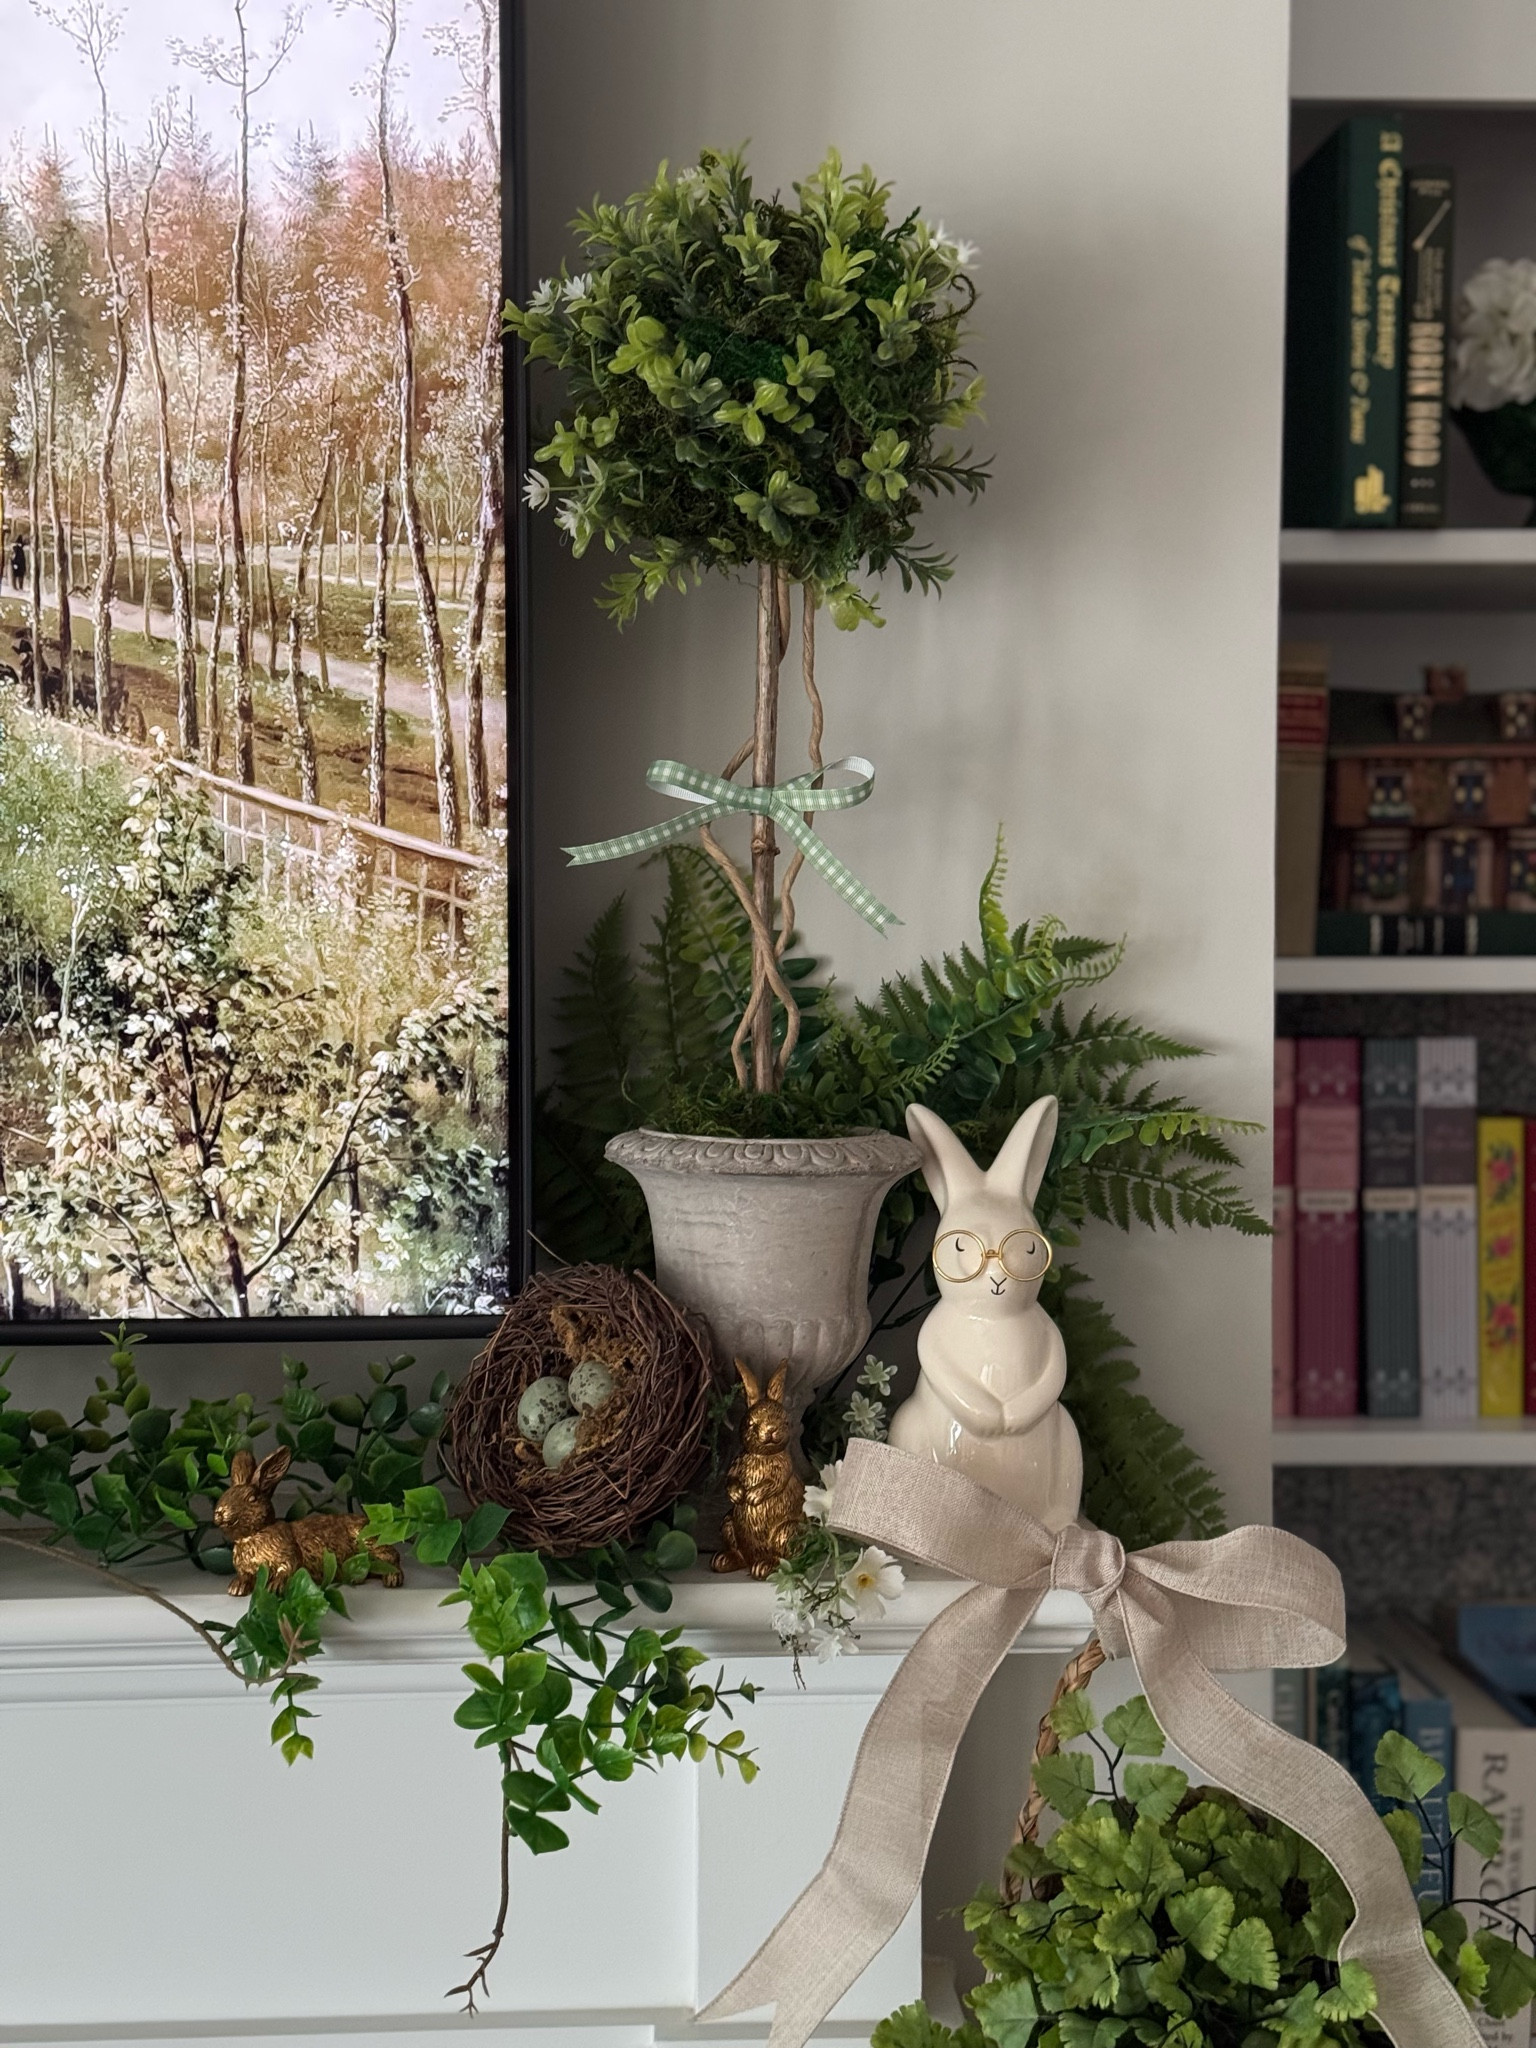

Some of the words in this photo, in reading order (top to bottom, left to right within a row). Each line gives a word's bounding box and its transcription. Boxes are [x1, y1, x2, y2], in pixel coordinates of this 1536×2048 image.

[1376, 158, 1402, 267] Christmas
[1408, 322, 1445, 396] ROBIN
[1405, 402, 1443, 466] HOOD
